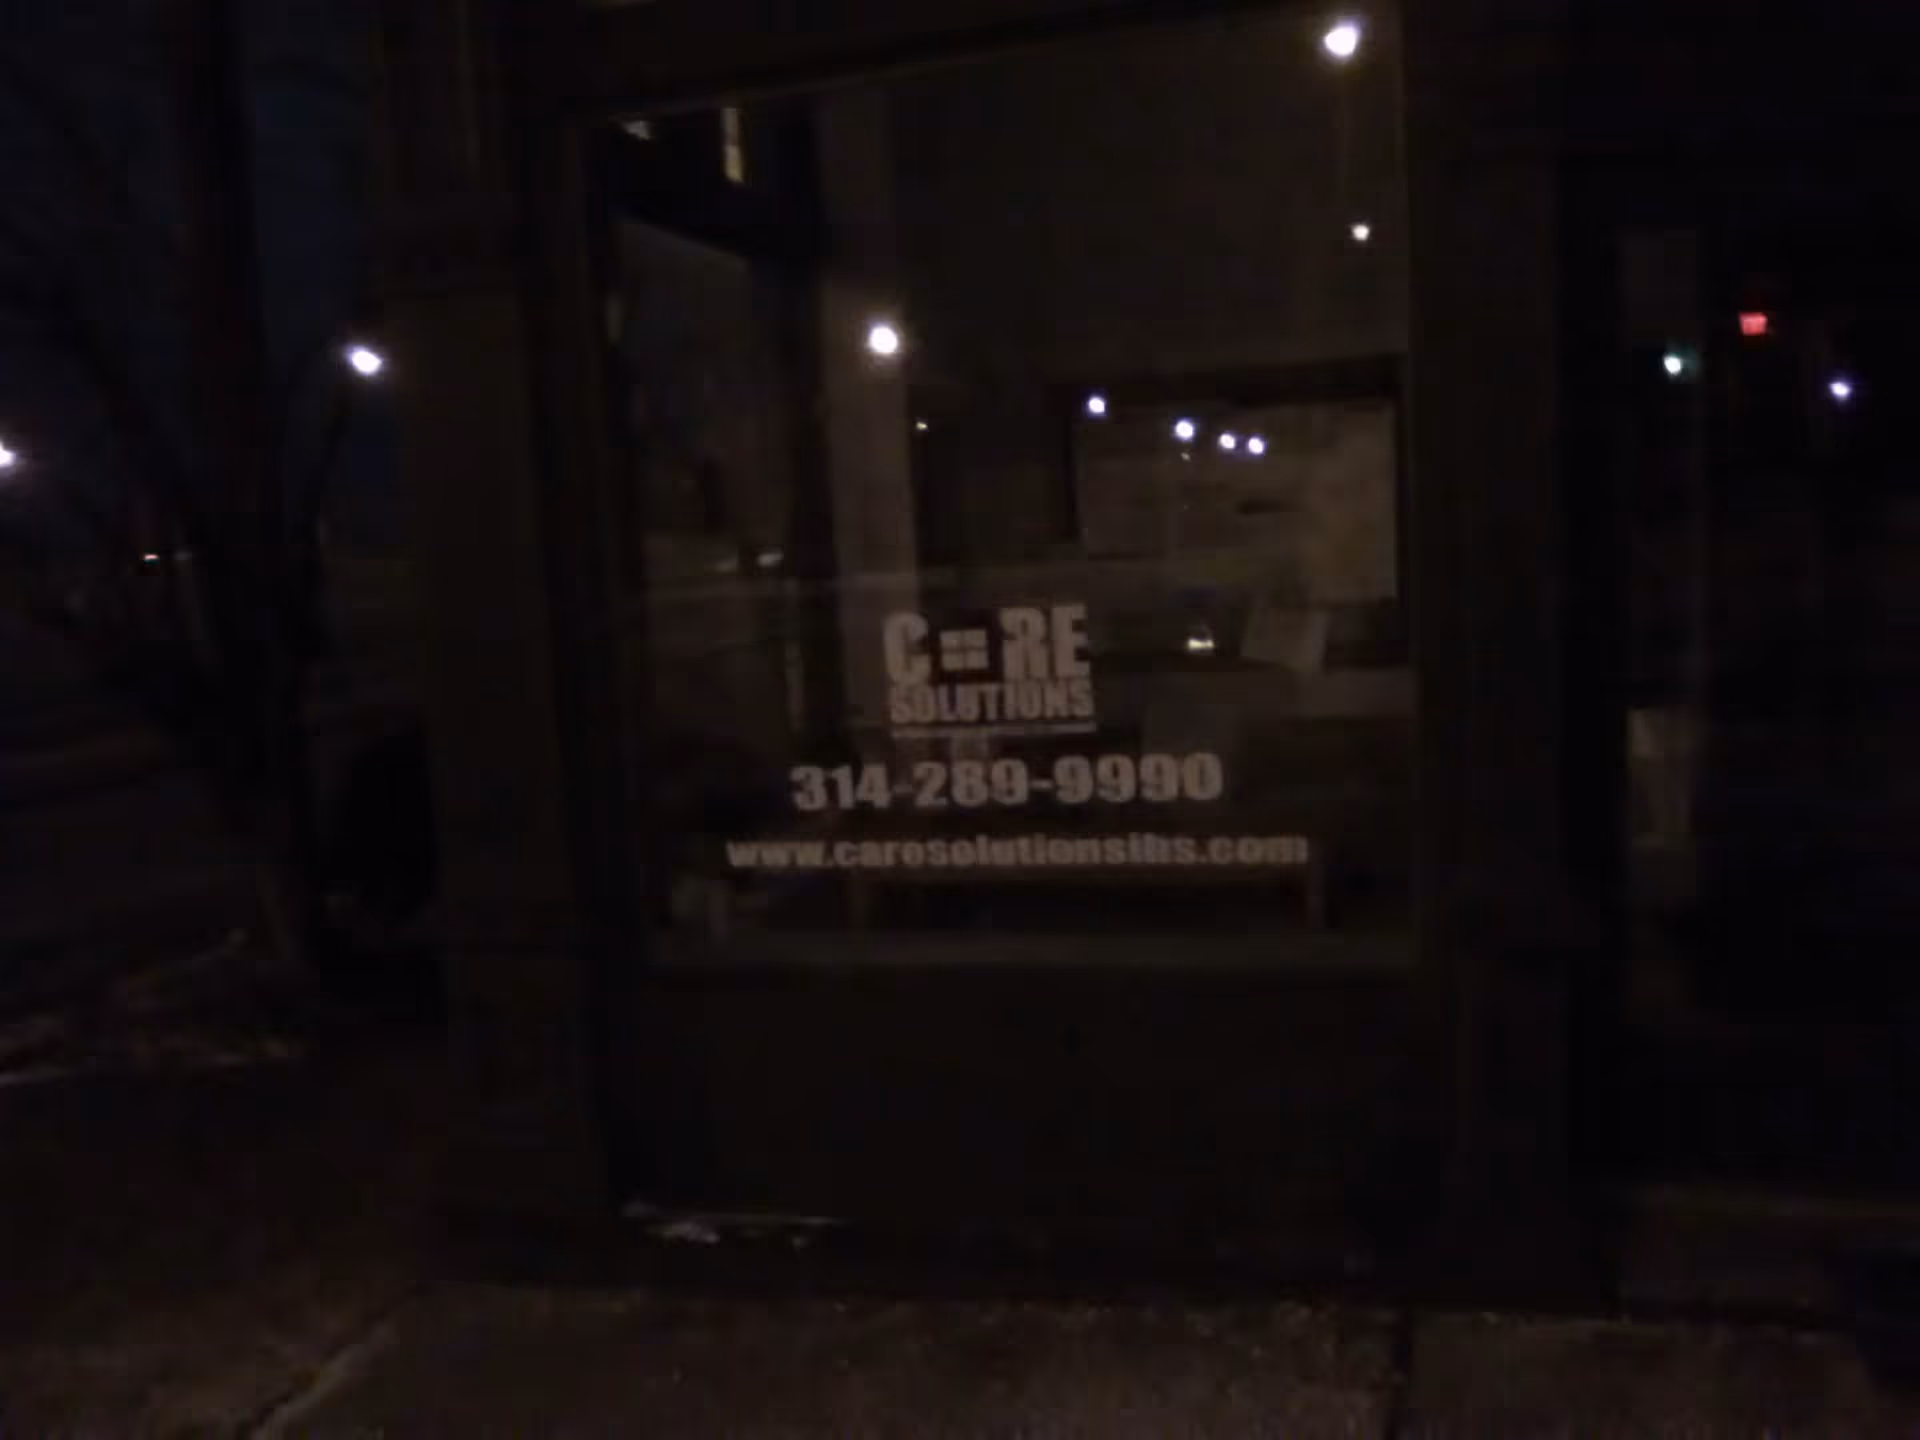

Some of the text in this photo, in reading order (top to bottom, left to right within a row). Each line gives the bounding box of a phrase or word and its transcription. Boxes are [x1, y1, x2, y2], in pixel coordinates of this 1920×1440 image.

[883, 603, 1091, 685] CRE
[889, 677, 1095, 723] SOLUTIONS
[789, 753, 1224, 811] 314-289-9990
